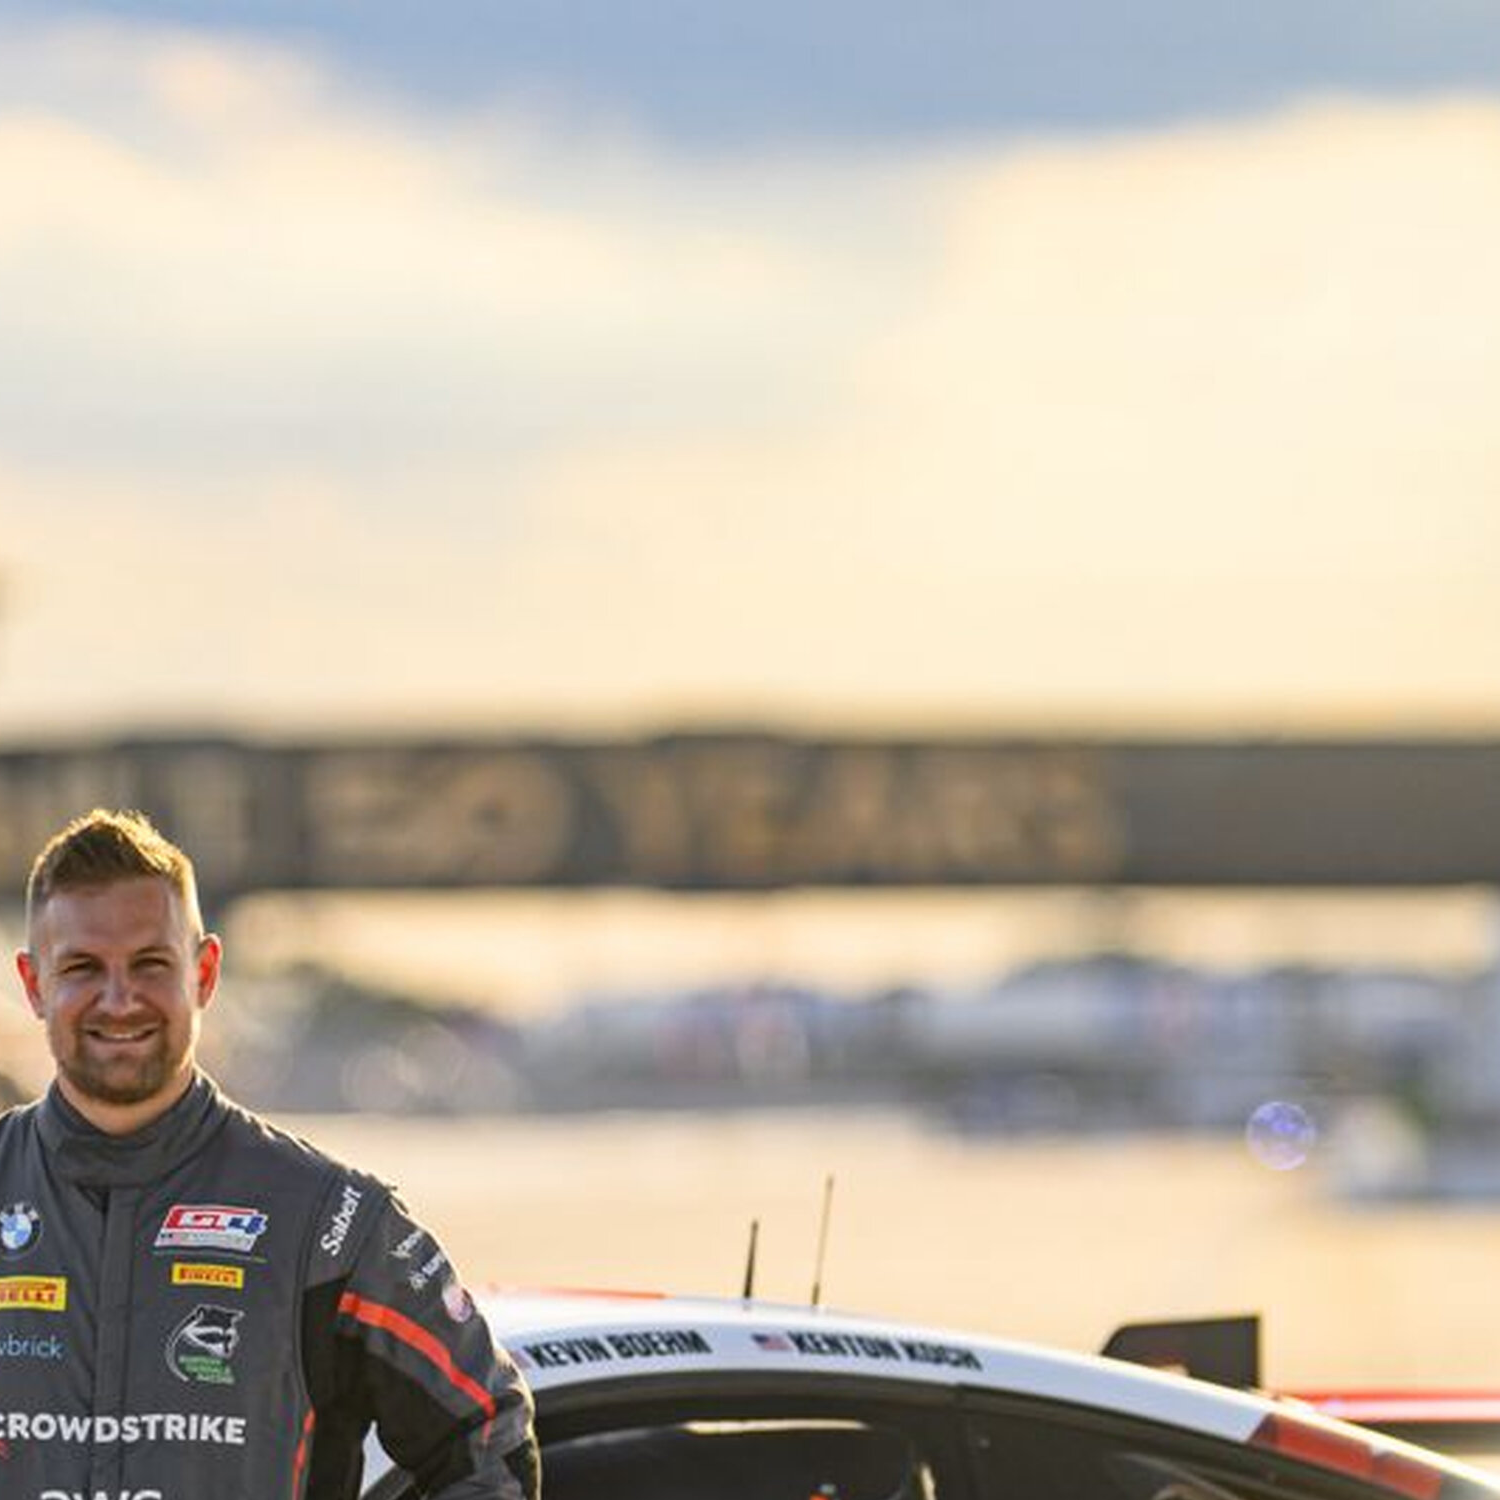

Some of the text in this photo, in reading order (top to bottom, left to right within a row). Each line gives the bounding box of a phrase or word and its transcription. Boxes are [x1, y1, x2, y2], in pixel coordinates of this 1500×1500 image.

[320, 1186, 362, 1256] Sabelt
[524, 1330, 713, 1370] KEVIN BOEHM
[787, 1332, 983, 1371] KENTON KOCH
